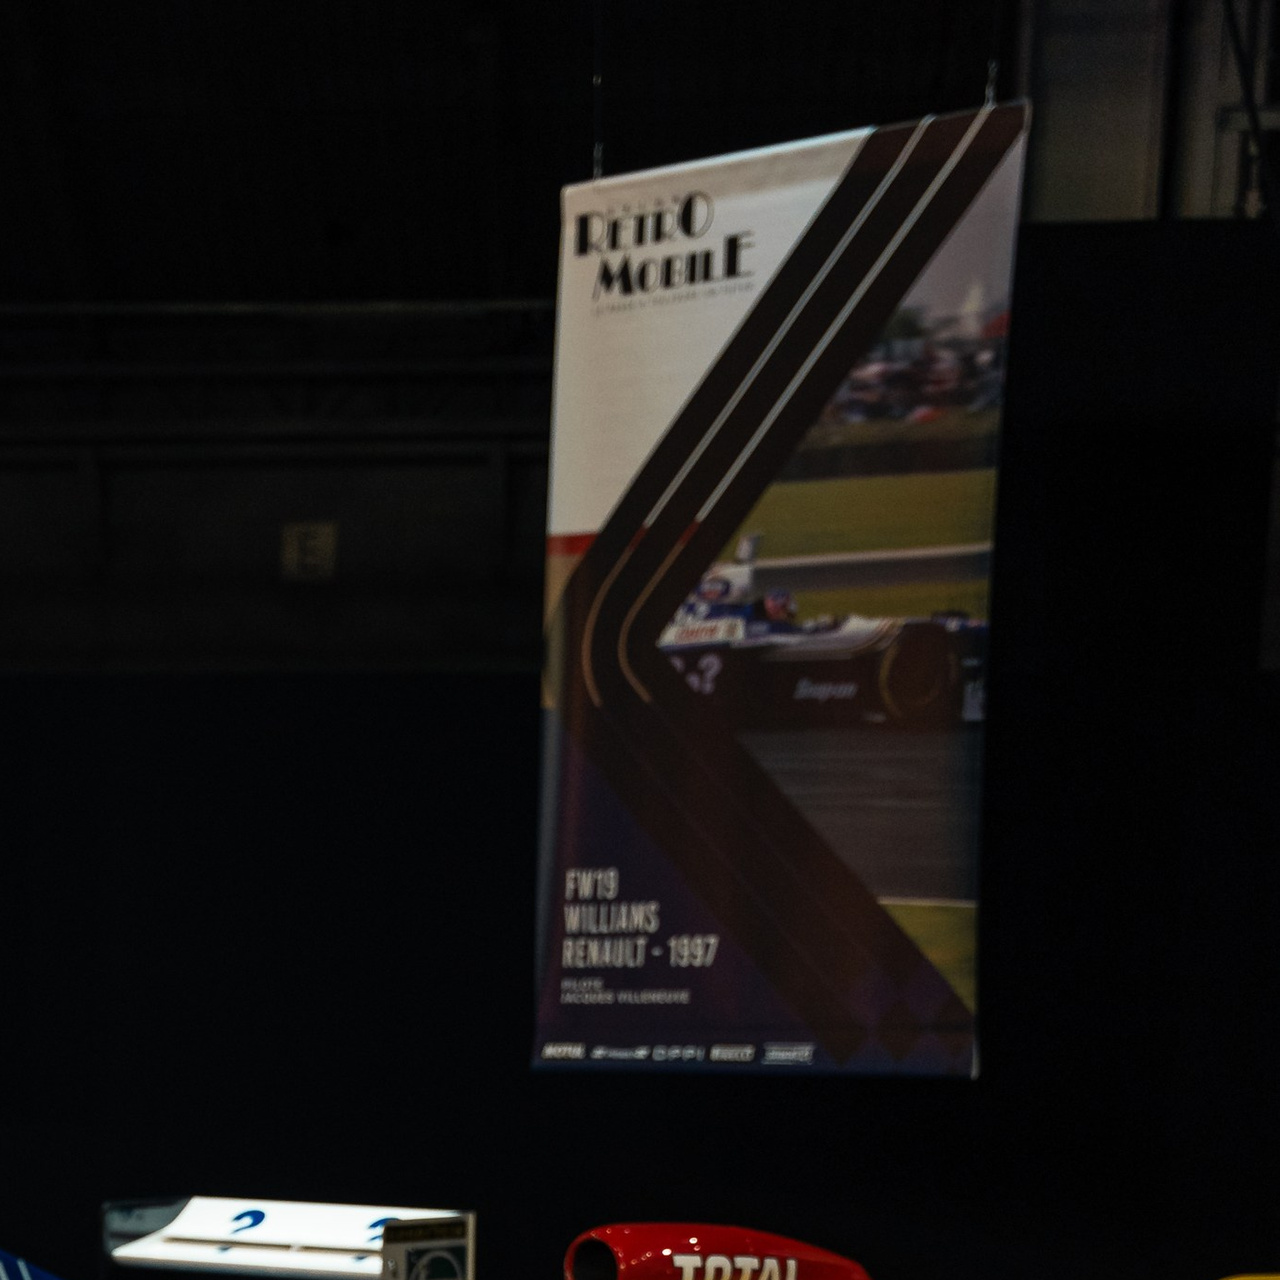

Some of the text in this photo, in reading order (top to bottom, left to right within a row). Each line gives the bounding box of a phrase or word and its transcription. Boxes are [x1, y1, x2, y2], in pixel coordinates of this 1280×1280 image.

[564, 901, 660, 934] WILLIAMS
[562, 936, 649, 968] RENAULT
[667, 934, 720, 968] 1997
